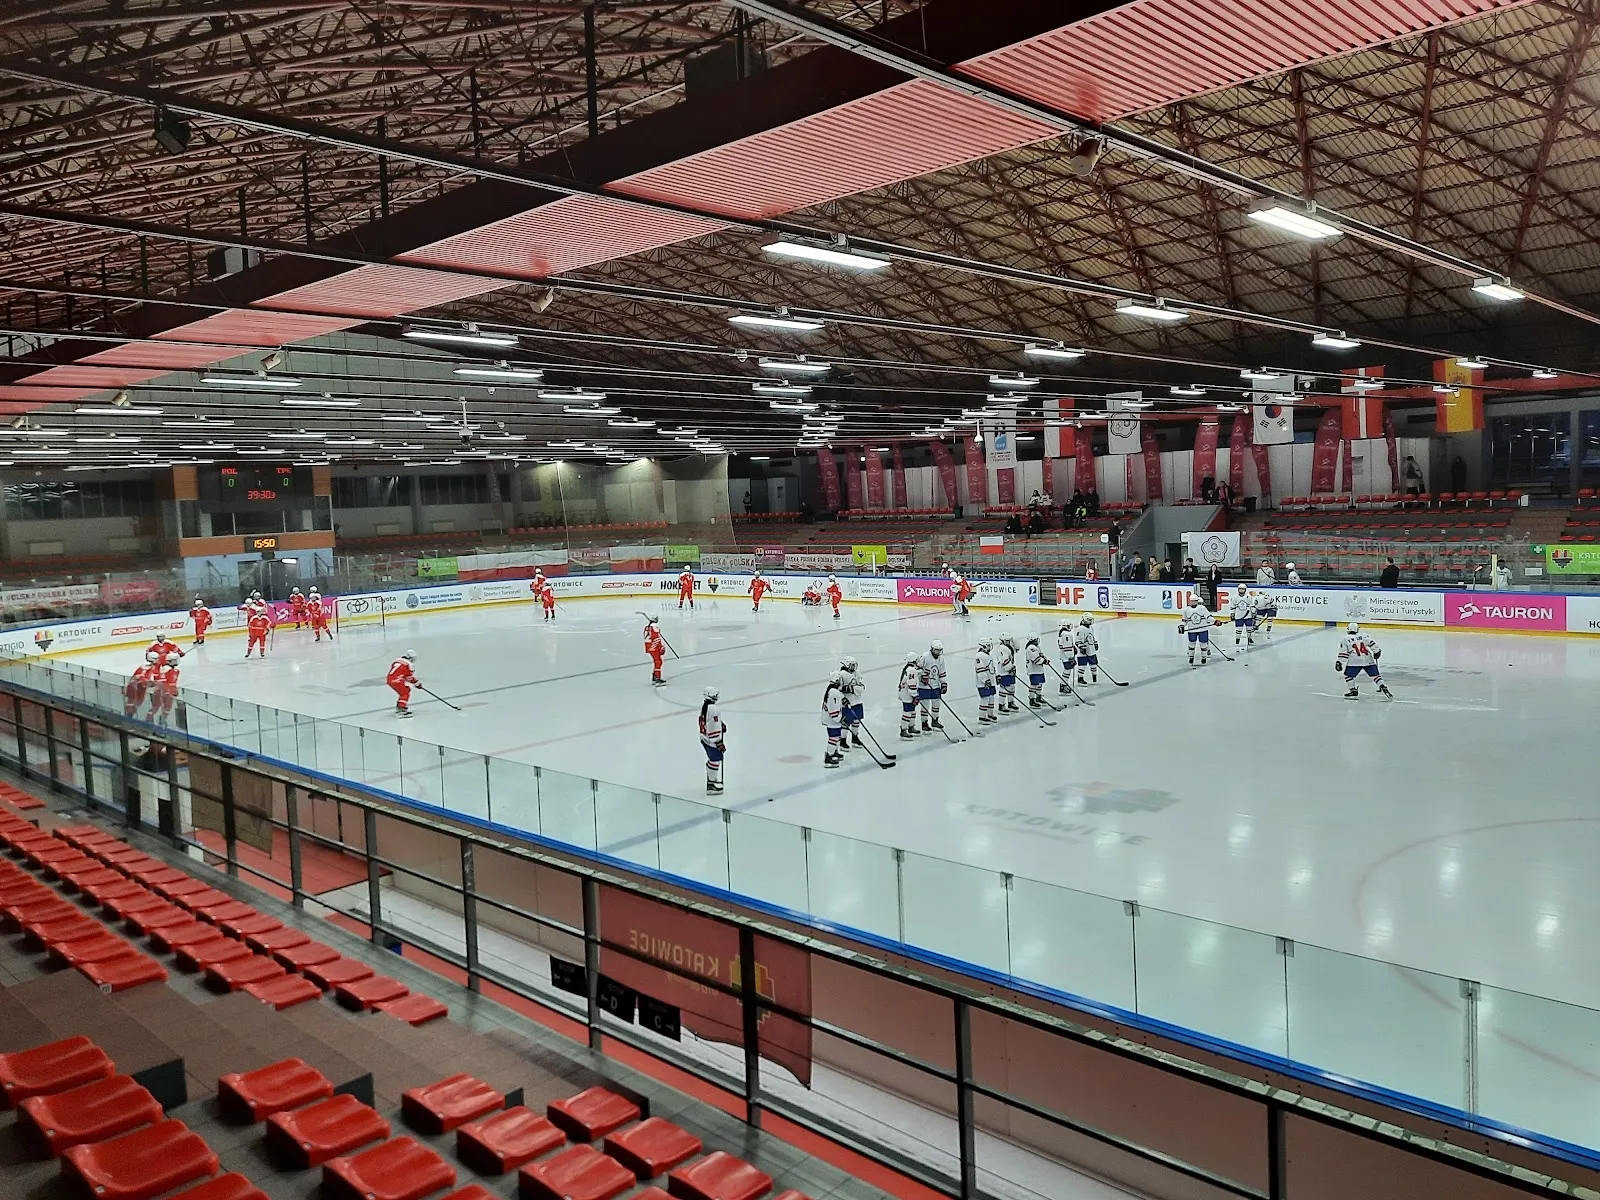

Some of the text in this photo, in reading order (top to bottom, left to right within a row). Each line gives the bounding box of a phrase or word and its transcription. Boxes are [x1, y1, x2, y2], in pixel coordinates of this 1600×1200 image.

[228, 478, 234, 487] 0
[283, 477, 289, 486] 0
[254, 538, 275, 549] 15:50
[915, 587, 950, 598] TAURON
[981, 586, 1017, 594] KATOWICE
[1275, 595, 1329, 605] KATOWICE
[1369, 597, 1419, 606] Ministerstwo
[1369, 606, 1394, 614] Sportu
[1400, 607, 1436, 616] Turystyki
[1482, 606, 1553, 620] TAURON
[58, 626, 102, 638] KATOWICE
[1352, 642, 1369, 656] 14
